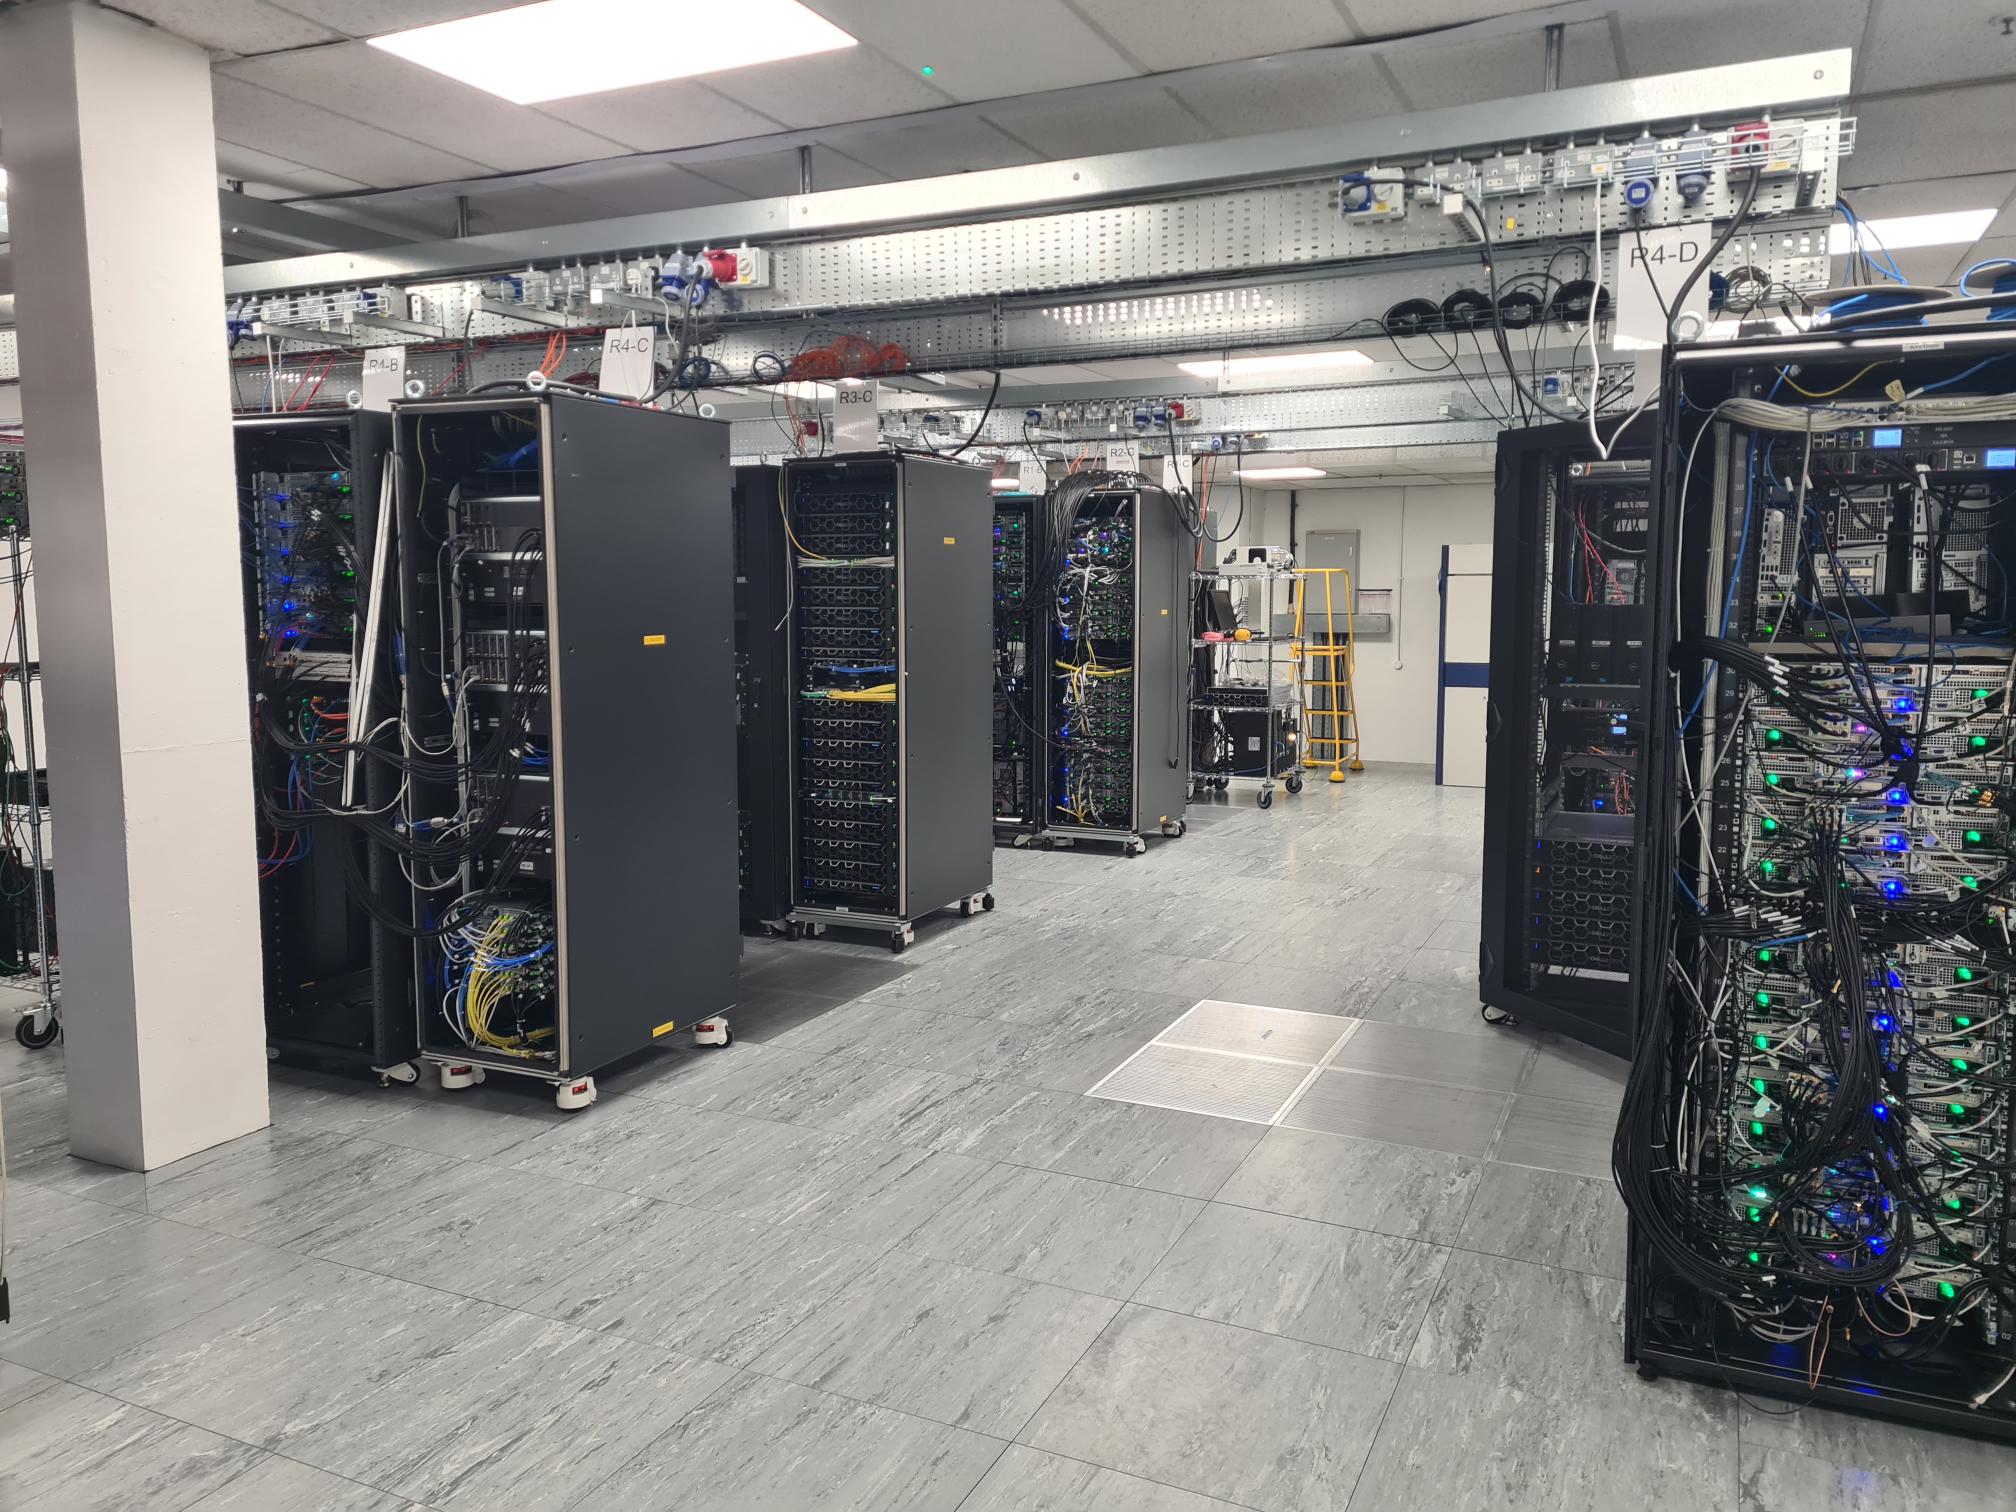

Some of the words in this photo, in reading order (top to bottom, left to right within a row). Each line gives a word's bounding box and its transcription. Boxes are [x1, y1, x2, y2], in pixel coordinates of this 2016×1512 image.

[1631, 241, 1698, 268] R4-D
[609, 336, 649, 353] R4-C
[368, 358, 399, 373] R4-B
[840, 390, 873, 404] R3-C
[1110, 447, 1135, 457] R2-C
